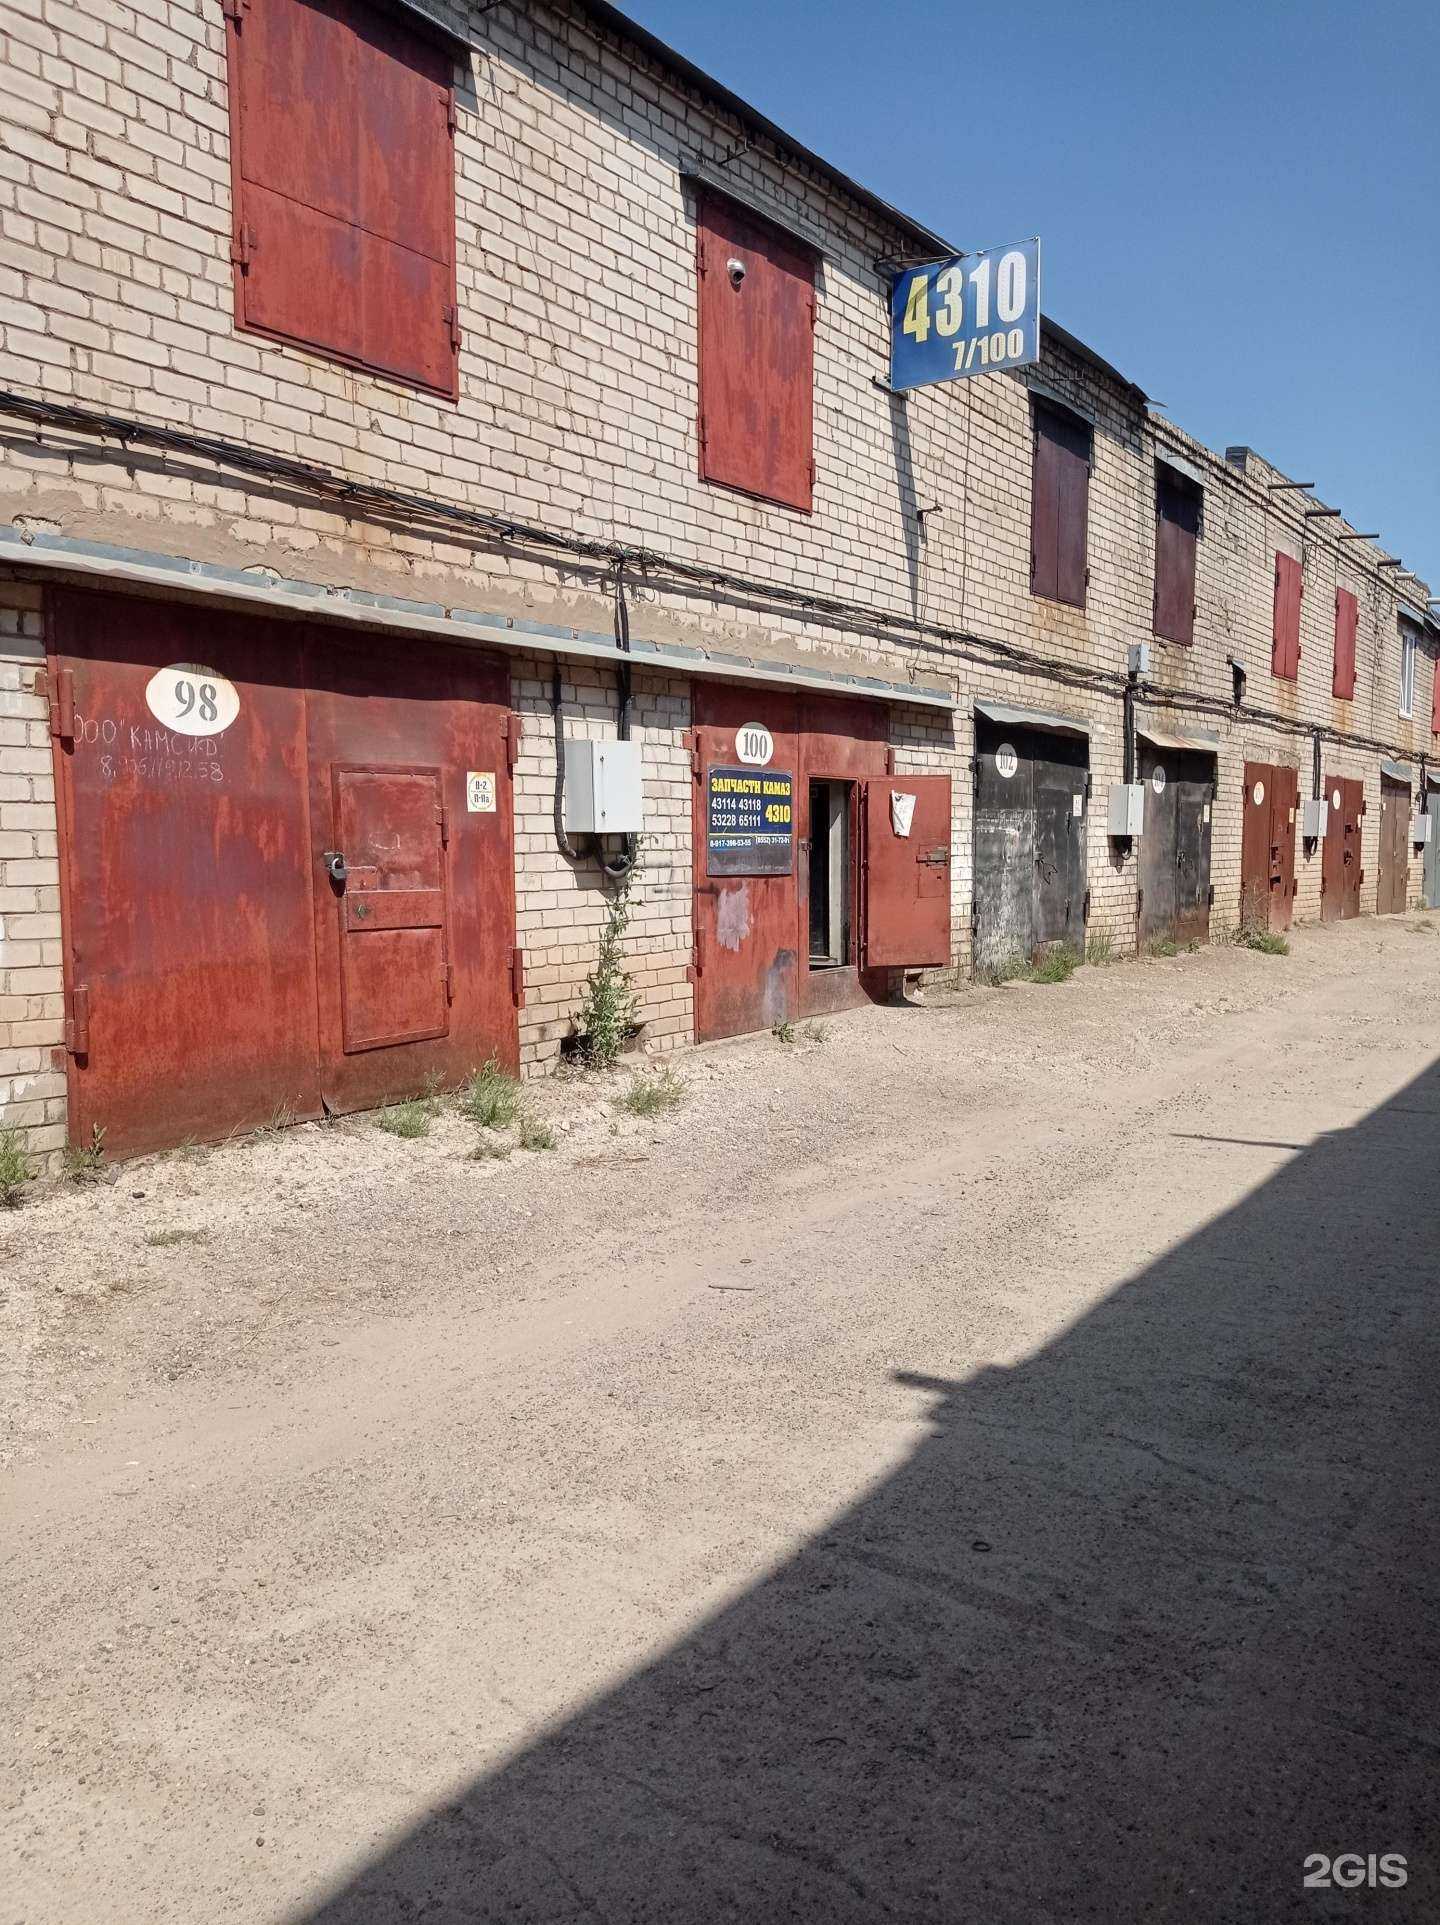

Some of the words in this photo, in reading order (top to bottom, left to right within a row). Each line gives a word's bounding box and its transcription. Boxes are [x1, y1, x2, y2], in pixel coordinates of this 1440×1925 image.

[903, 251, 1027, 343] 4310
[952, 328, 1024, 371] 7/100
[175, 680, 218, 721] 98
[743, 731, 768, 759] 100
[1000, 751, 1014, 771] 102
[711, 777, 761, 794] ЗАПЧАСТИ
[763, 781, 791, 796] КАМАЗ
[711, 797, 737, 810] 43114
[738, 798, 762, 811] 43118
[765, 804, 791, 823] 4310
[711, 814, 737, 827] 53228
[738, 815, 761, 827] 65111
